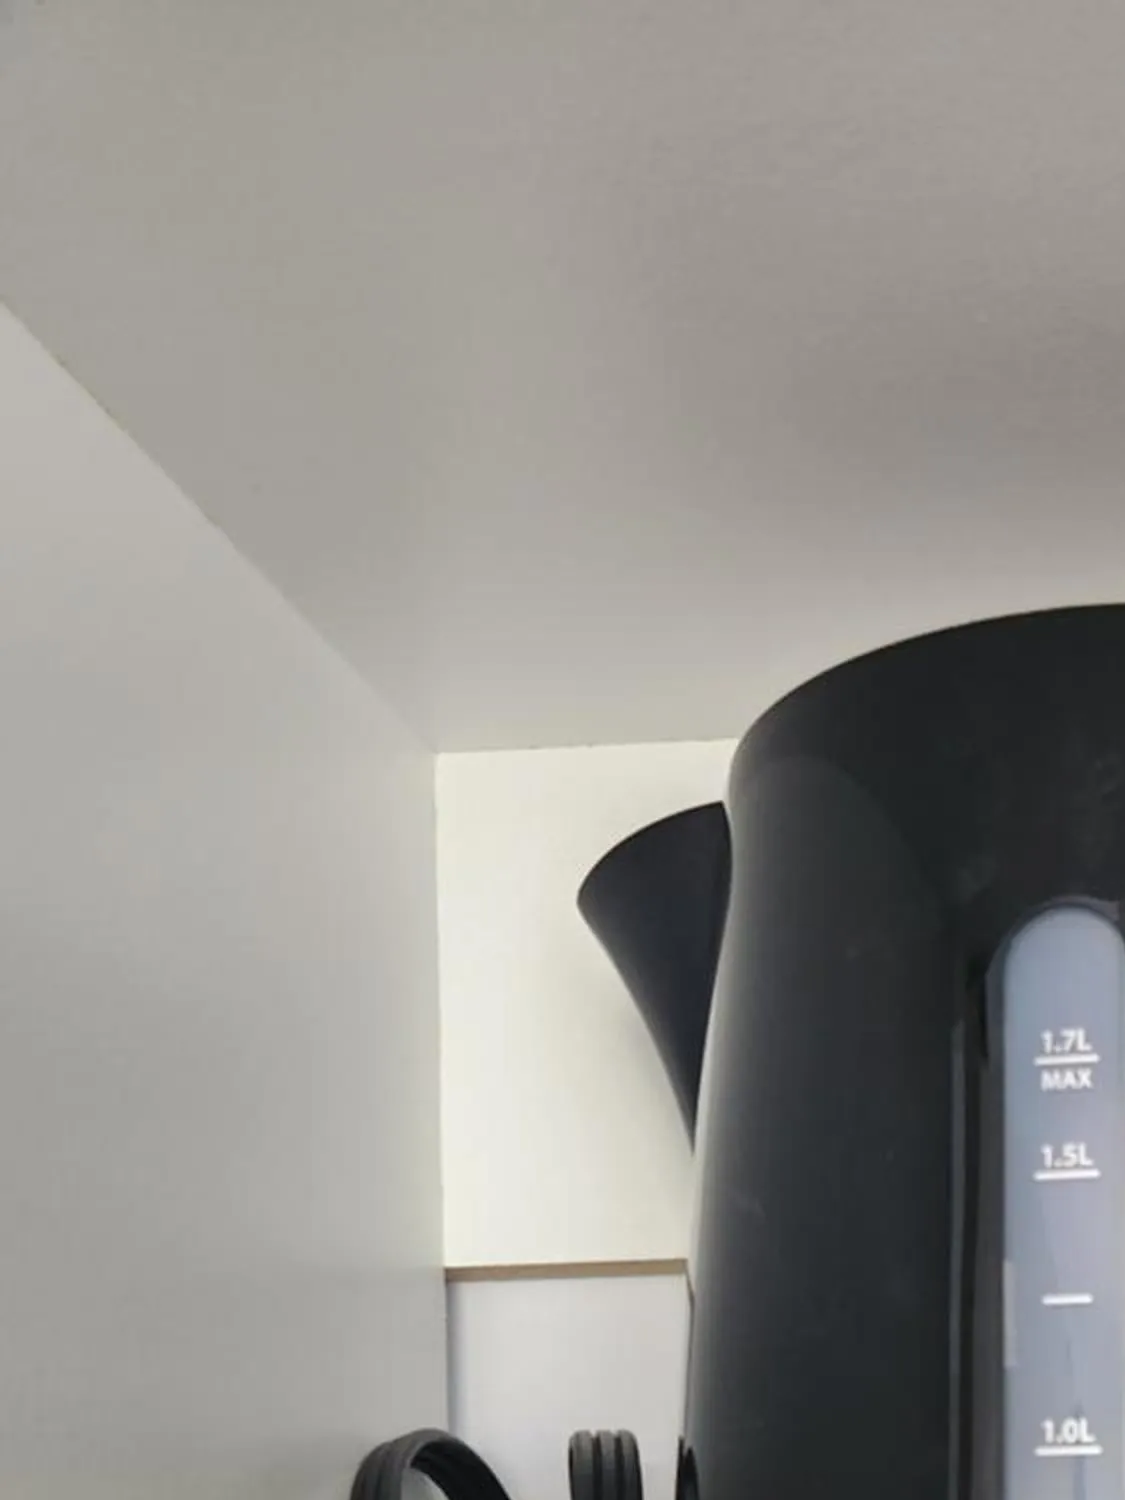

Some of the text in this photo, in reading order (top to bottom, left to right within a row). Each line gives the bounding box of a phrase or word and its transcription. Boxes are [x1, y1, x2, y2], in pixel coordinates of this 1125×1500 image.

[1039, 1027, 1093, 1054] 1.7L
[1040, 1068, 1093, 1091] MAX
[1039, 1142, 1094, 1168] 1.5L
[1040, 1416, 1096, 1443] 1.0L
